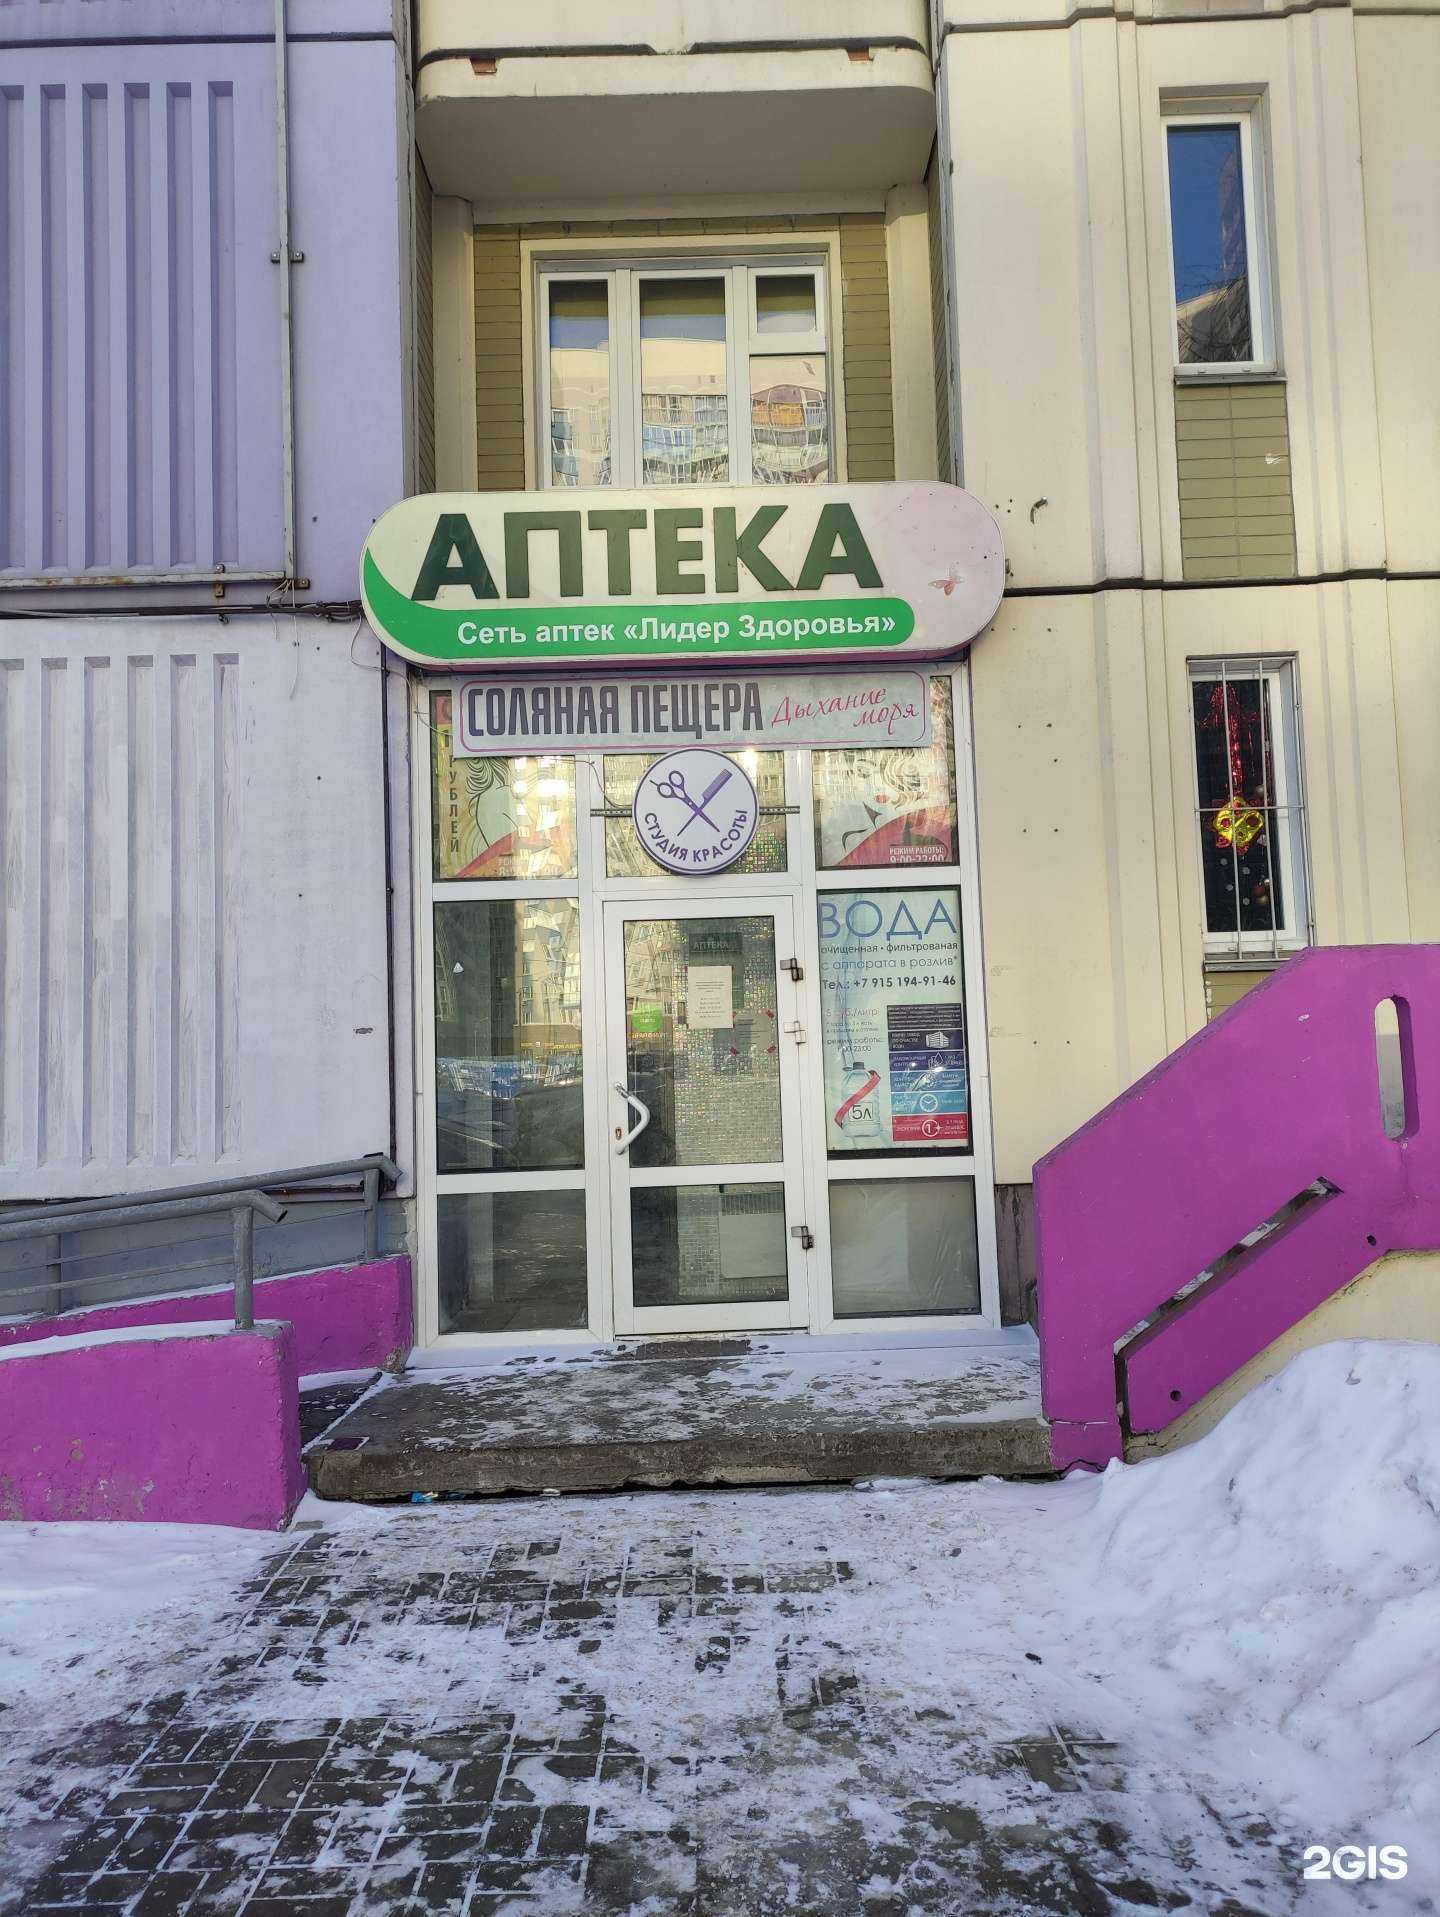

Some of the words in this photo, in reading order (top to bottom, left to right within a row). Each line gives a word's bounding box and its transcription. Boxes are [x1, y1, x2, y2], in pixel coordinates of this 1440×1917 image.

[411, 503, 884, 600] АПТЕКА
[457, 621, 527, 645] Сеть
[535, 623, 615, 643] аптек
[623, 617, 730, 643] «Лидер
[738, 614, 896, 641] Здоровья»
[468, 685, 620, 737] СОЛЯНАЯ
[630, 682, 764, 739] ПЕЩЕРА
[771, 688, 887, 728] Дыхание
[853, 703, 919, 736] моря
[644, 812, 689, 861] СТУДИЯ
[693, 809, 748, 863] КРАСОТЫ
[819, 899, 957, 940] ВОДА
[820, 945, 878, 955] очищенная
[886, 941, 958, 954] фильтрованая
[900, 959, 906, 968] в
[854, 978, 868, 988] +7
[872, 977, 893, 988] 915
[897, 975, 957, 987] 194-91-46
